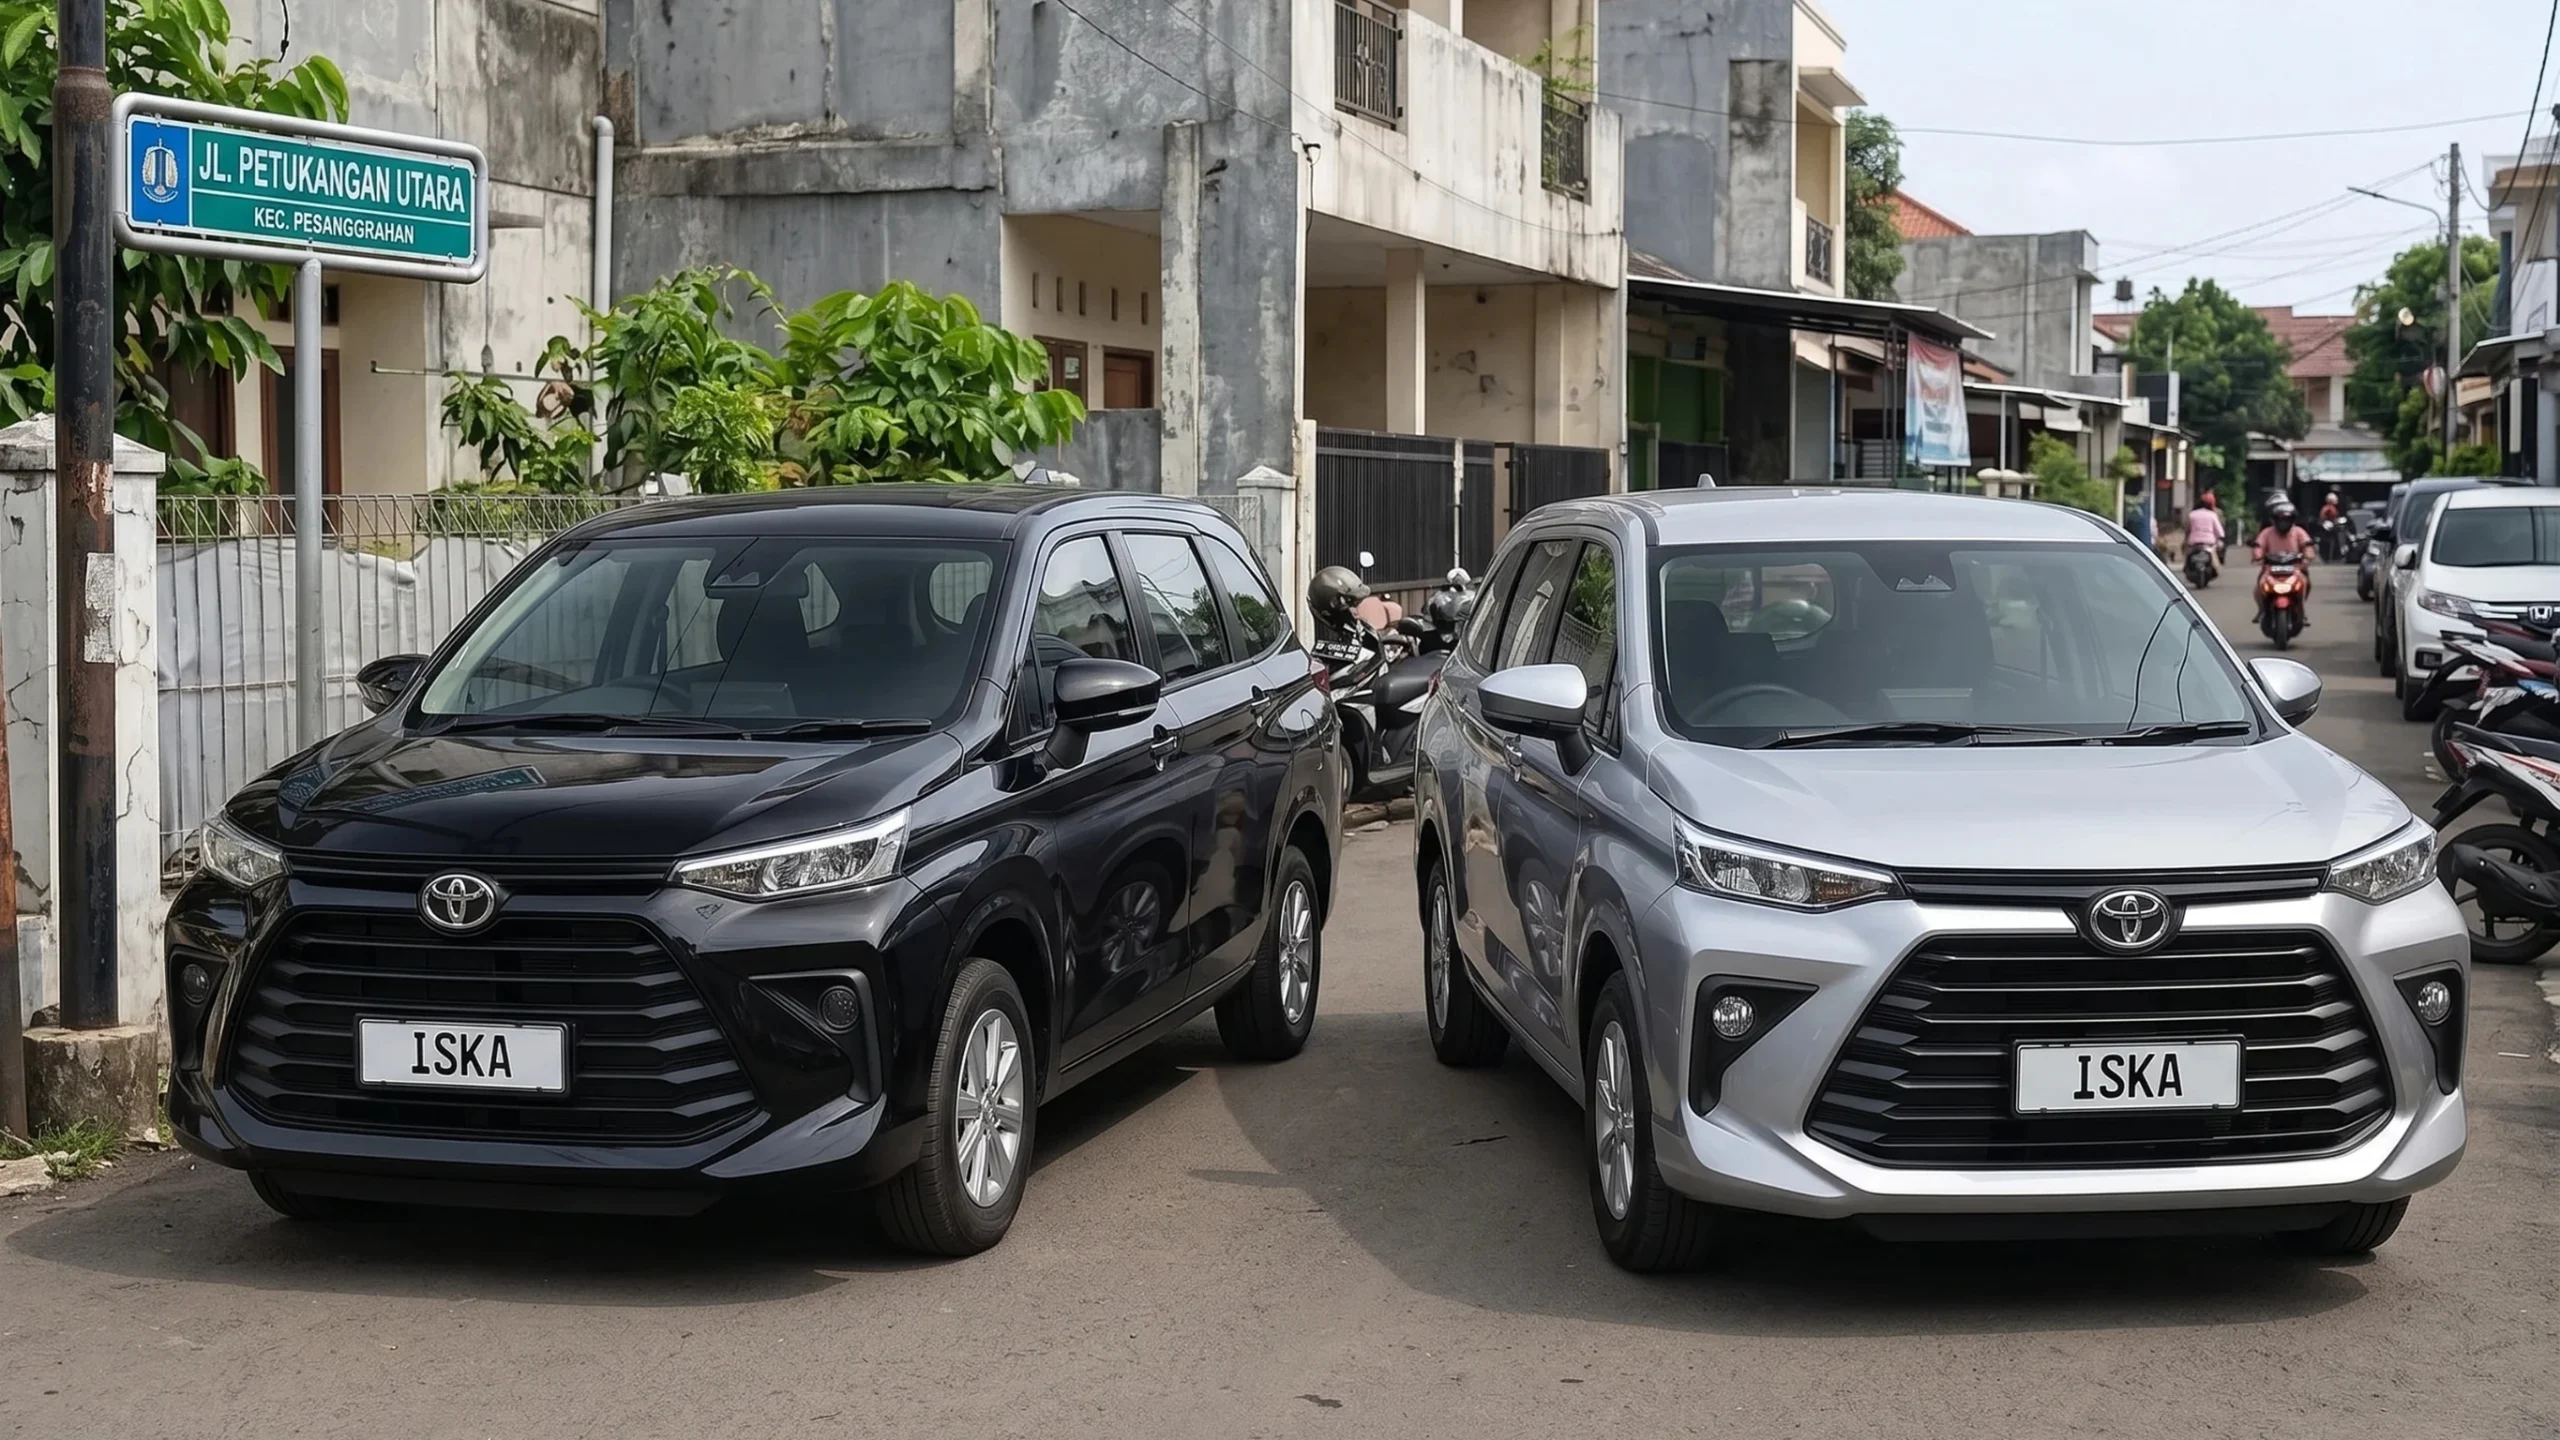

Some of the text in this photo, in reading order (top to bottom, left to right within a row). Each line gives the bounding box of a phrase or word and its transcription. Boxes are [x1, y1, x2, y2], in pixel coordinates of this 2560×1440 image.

[199, 141, 466, 214] JL. PETUKANGAN UTARA
[254, 206, 414, 245] KEC. PESANGGRAHAN
[411, 1031, 512, 1078] ISKA
[2073, 1053, 2183, 1100] ISKA
